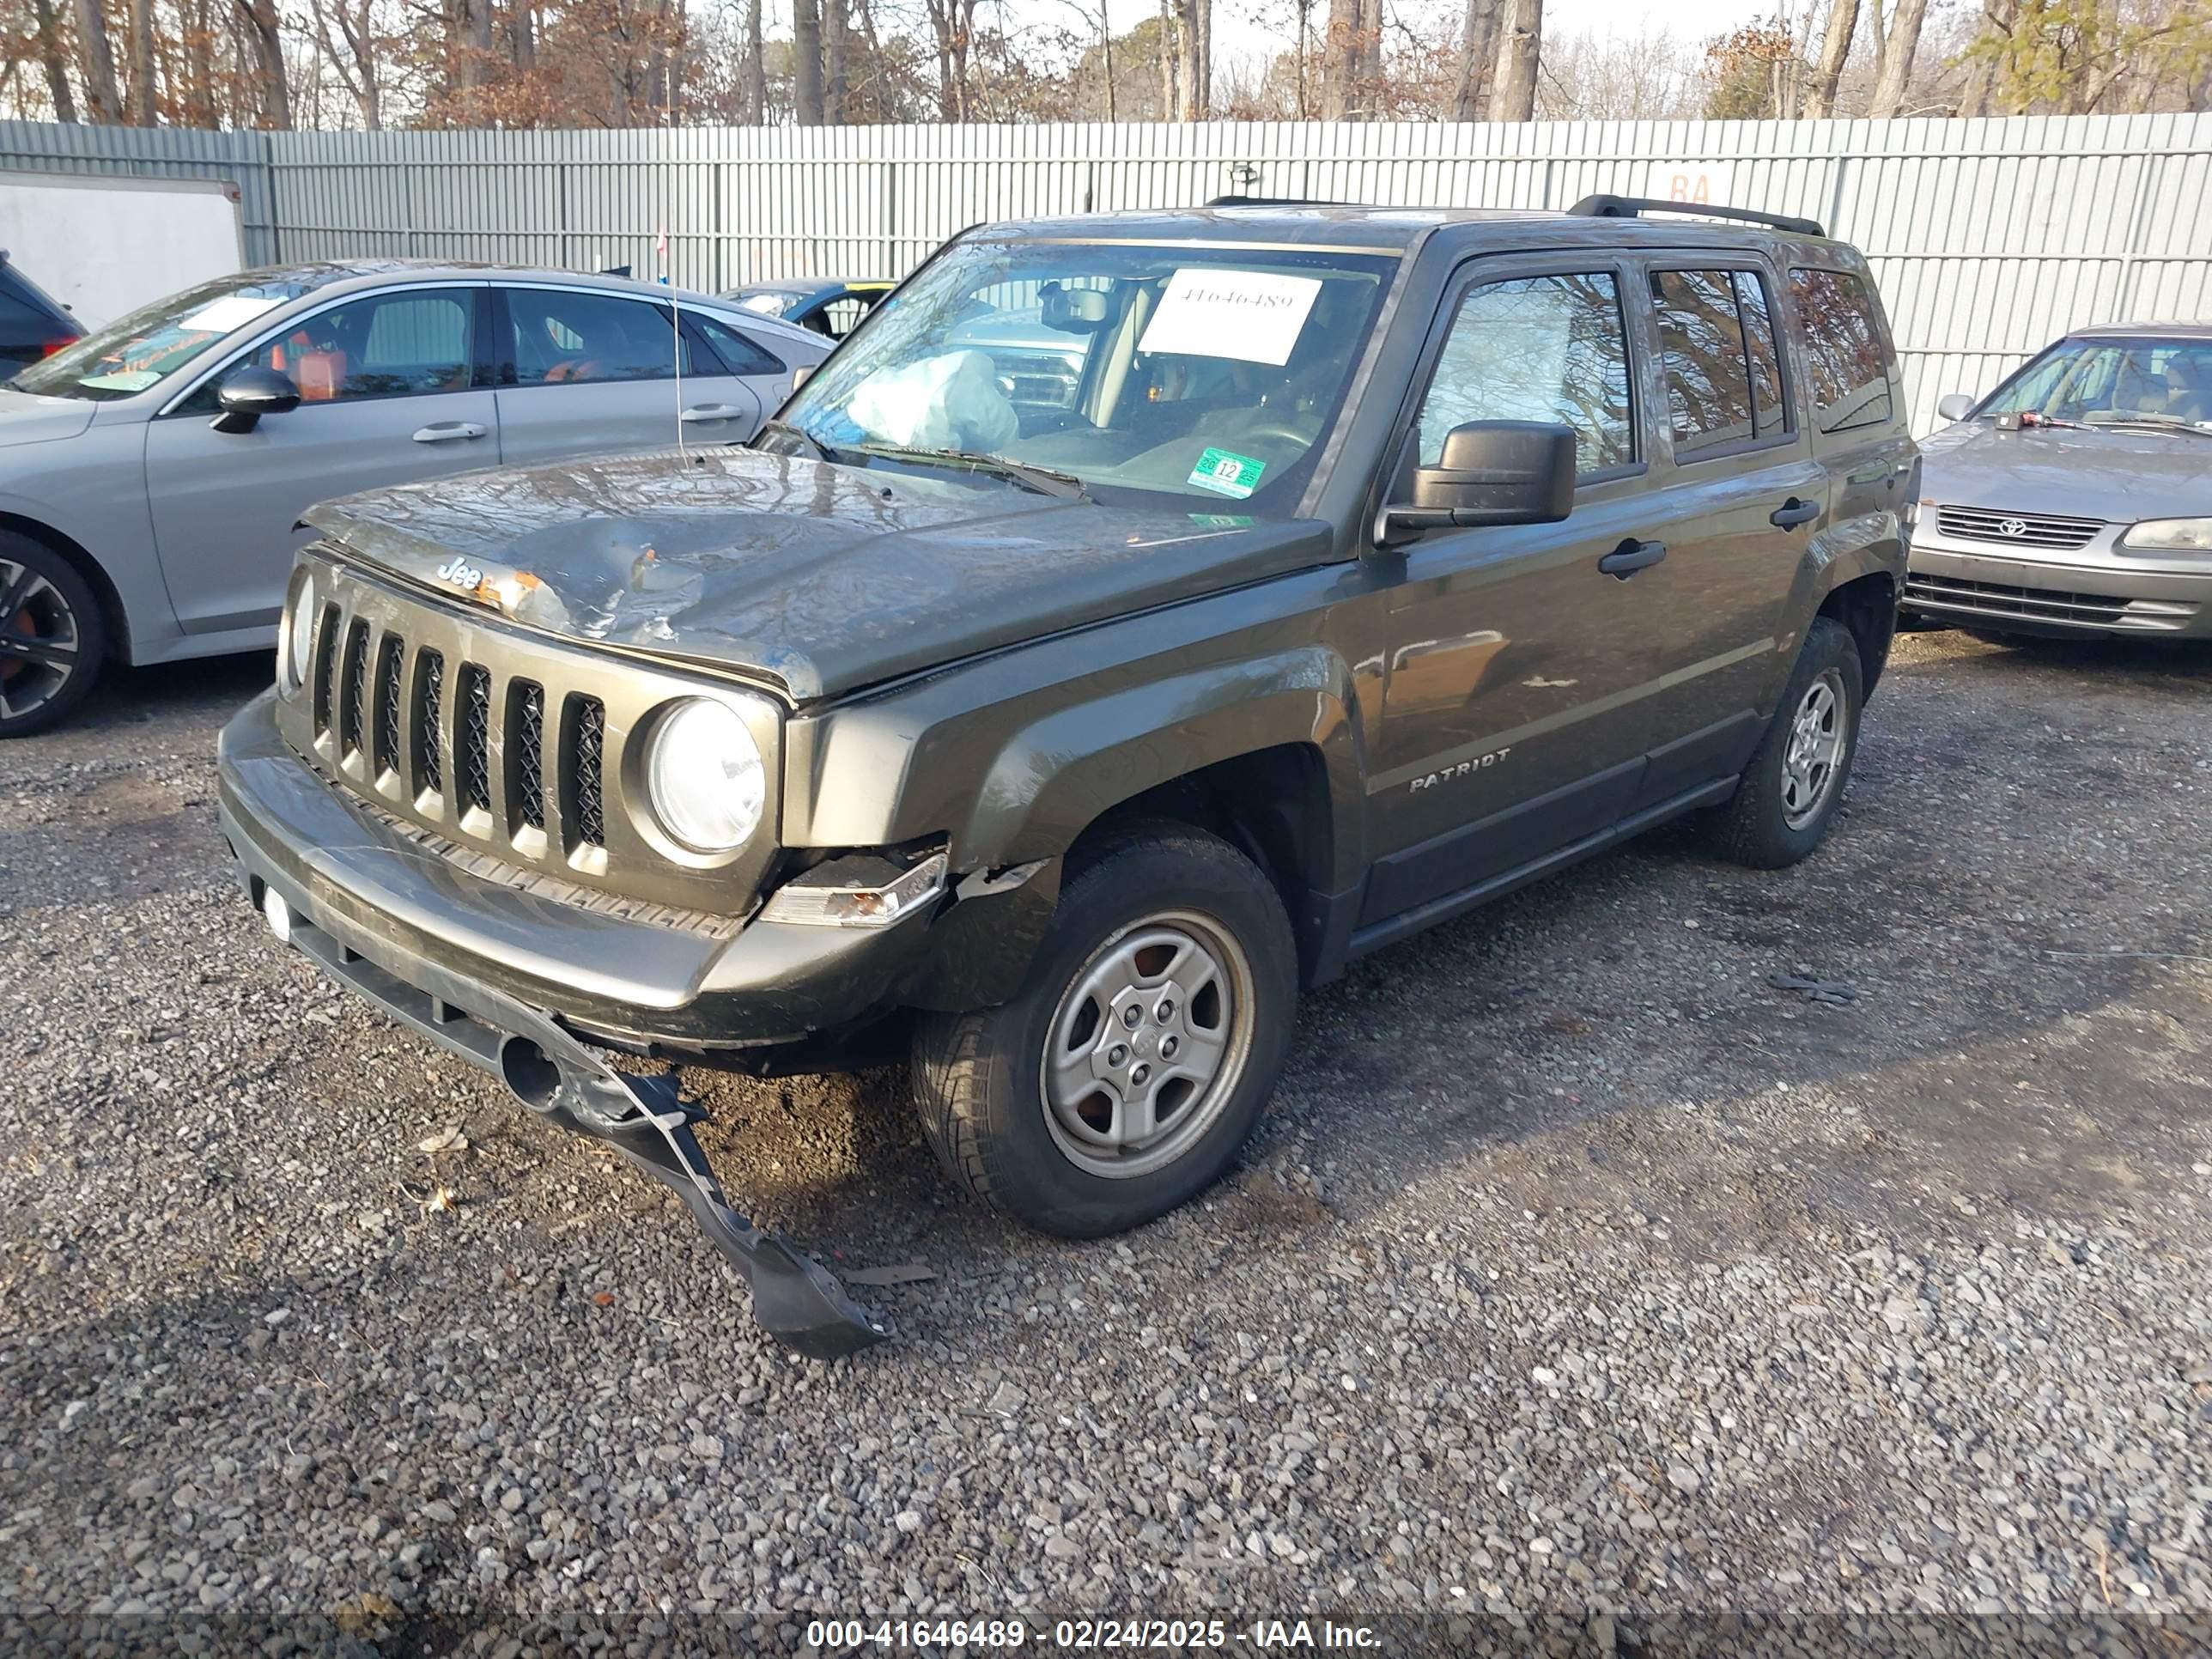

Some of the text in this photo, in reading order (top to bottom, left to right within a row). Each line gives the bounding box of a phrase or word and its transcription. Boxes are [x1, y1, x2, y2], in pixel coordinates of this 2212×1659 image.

[1218, 462, 1237, 478] 12
[437, 556, 493, 592] Jee
[1409, 747, 1511, 793] PATRIOT
